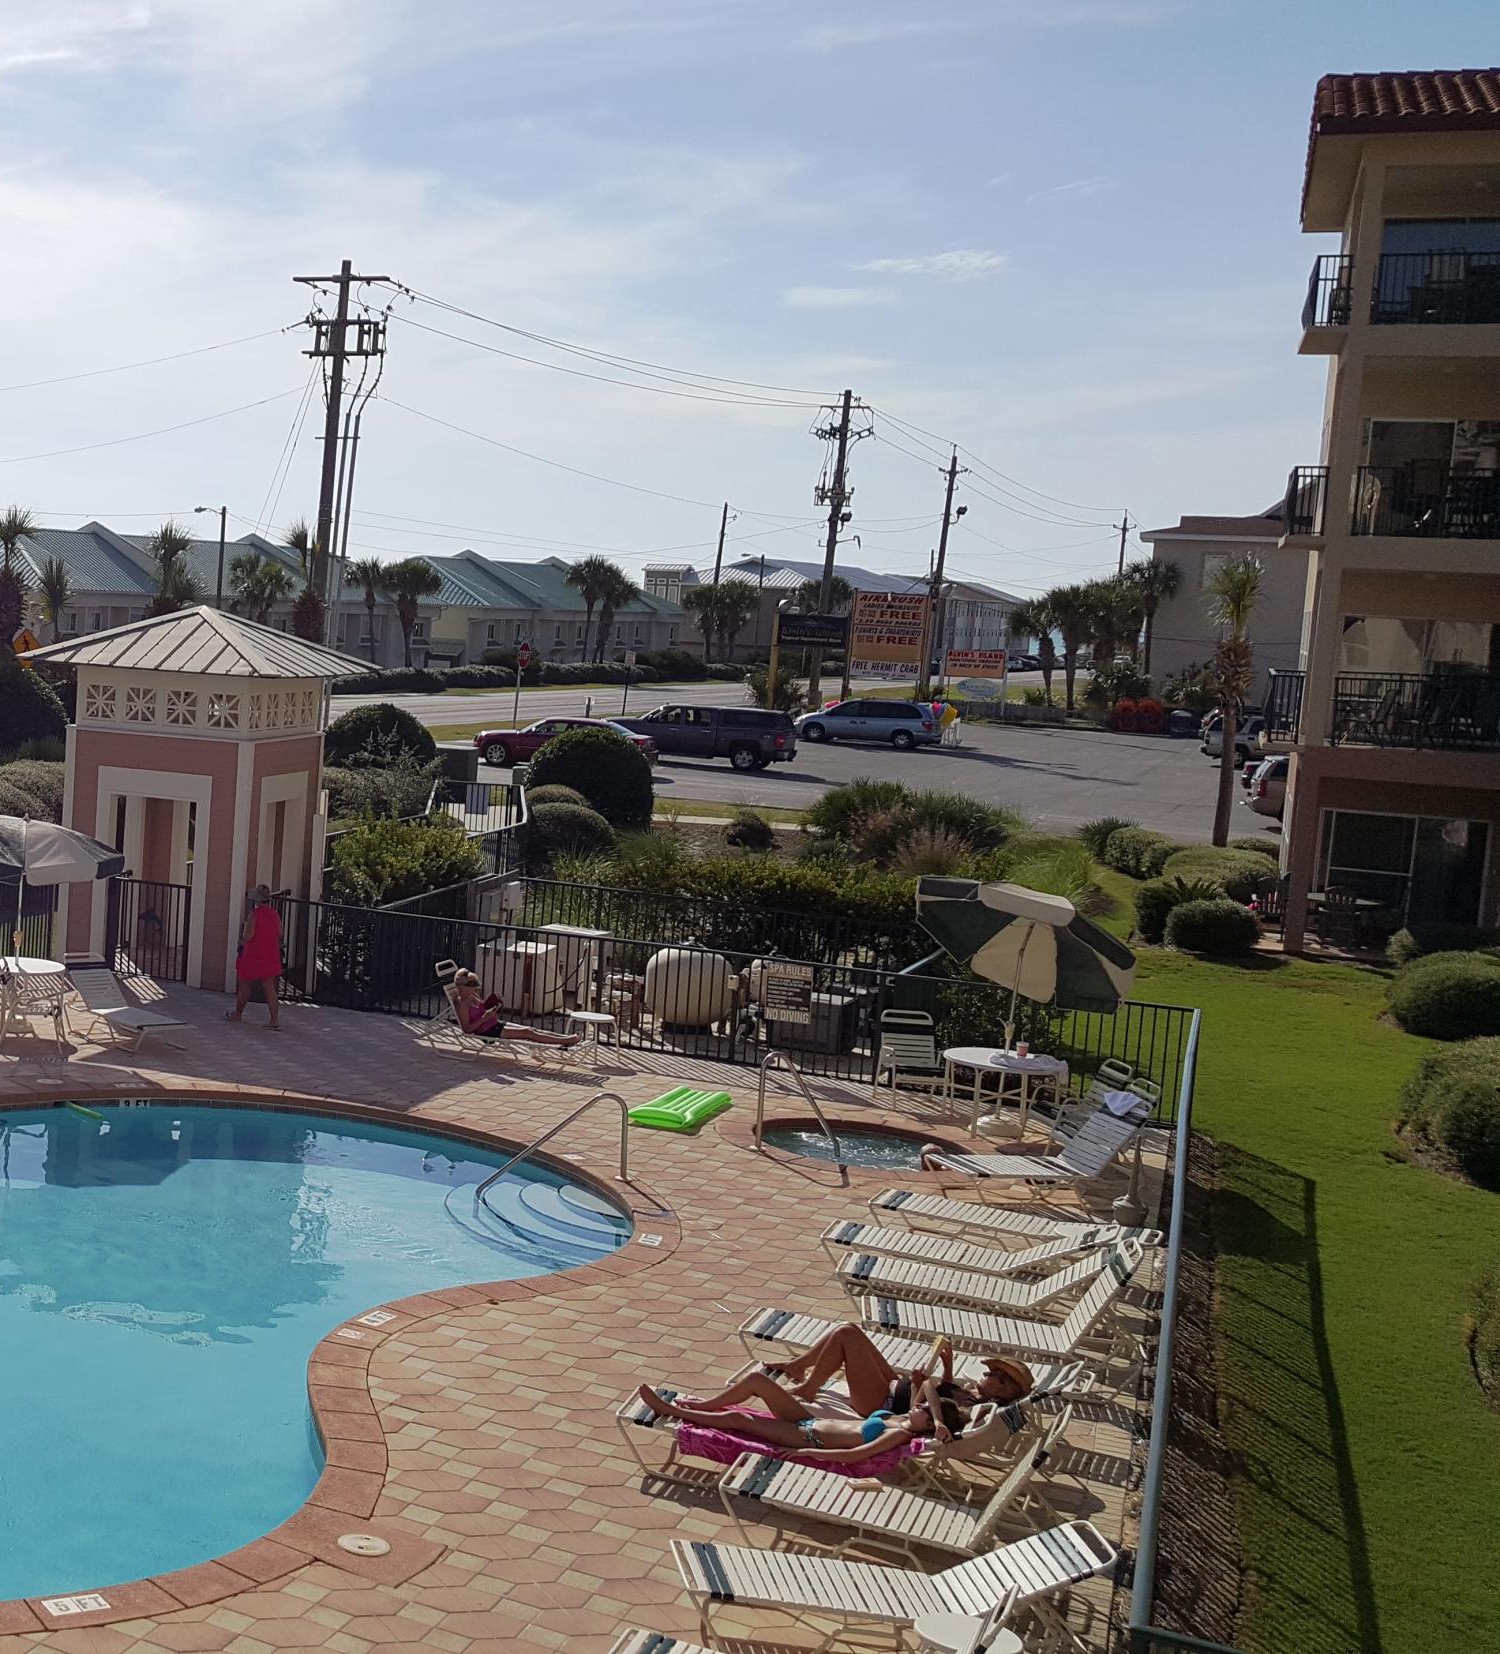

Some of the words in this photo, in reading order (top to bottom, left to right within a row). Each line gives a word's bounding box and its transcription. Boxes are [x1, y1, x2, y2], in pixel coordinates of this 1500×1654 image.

[860, 594, 924, 605] AIRBRUSH
[879, 610, 924, 620] FREE
[876, 635, 918, 646] FREE
[852, 660, 869, 670] FREE
[870, 662, 898, 672] HERMIT
[900, 664, 919, 674] CRAB
[769, 963, 784, 974] SPA
[786, 965, 812, 977] RULES
[766, 1007, 778, 1020] NO
[780, 1009, 809, 1023] DIVING
[53, 1600, 70, 1612] 5
[76, 1596, 107, 1609] FT
